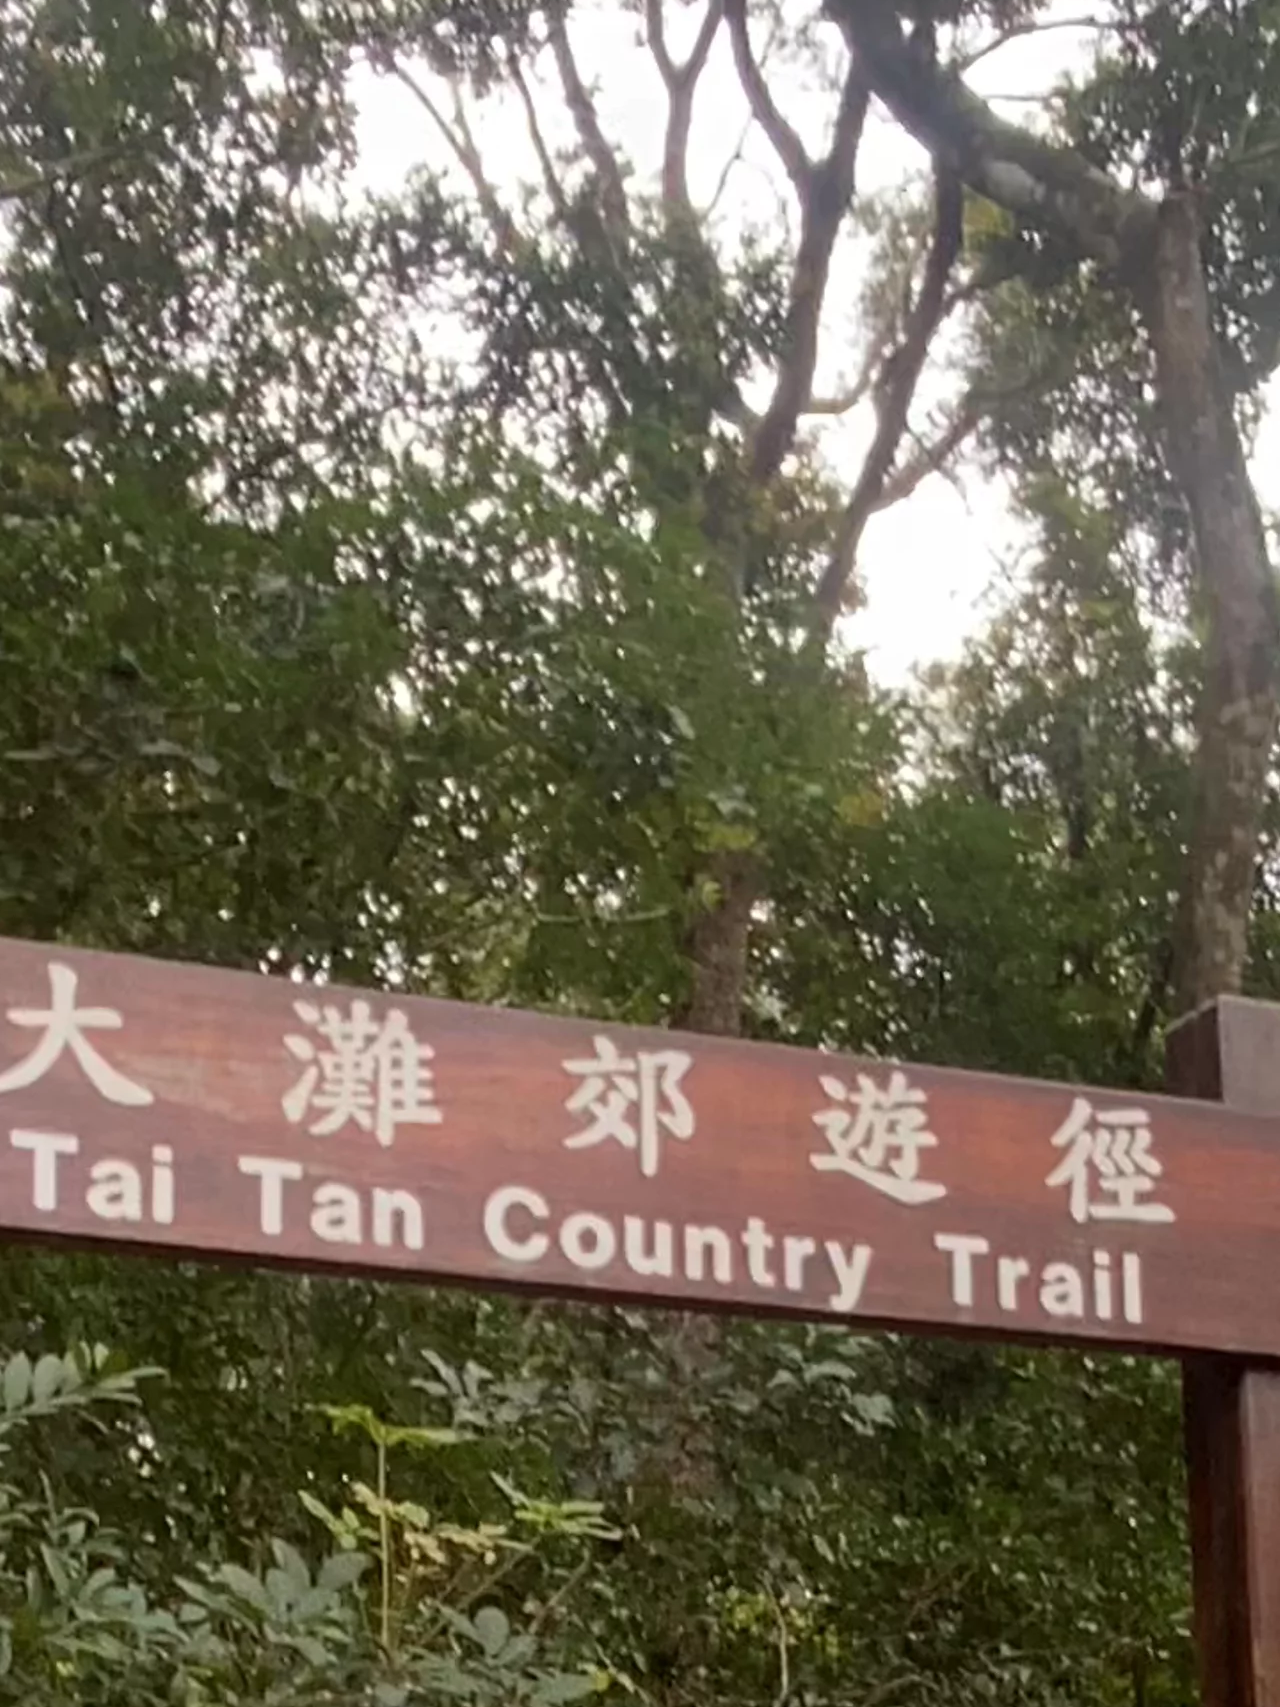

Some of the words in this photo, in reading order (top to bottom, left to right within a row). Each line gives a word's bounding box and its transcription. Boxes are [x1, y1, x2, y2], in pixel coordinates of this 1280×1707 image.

[10, 1128, 175, 1225] Tai
[238, 1154, 424, 1251] Tan
[483, 1186, 873, 1313] Country
[934, 1233, 1144, 1325] Trail
